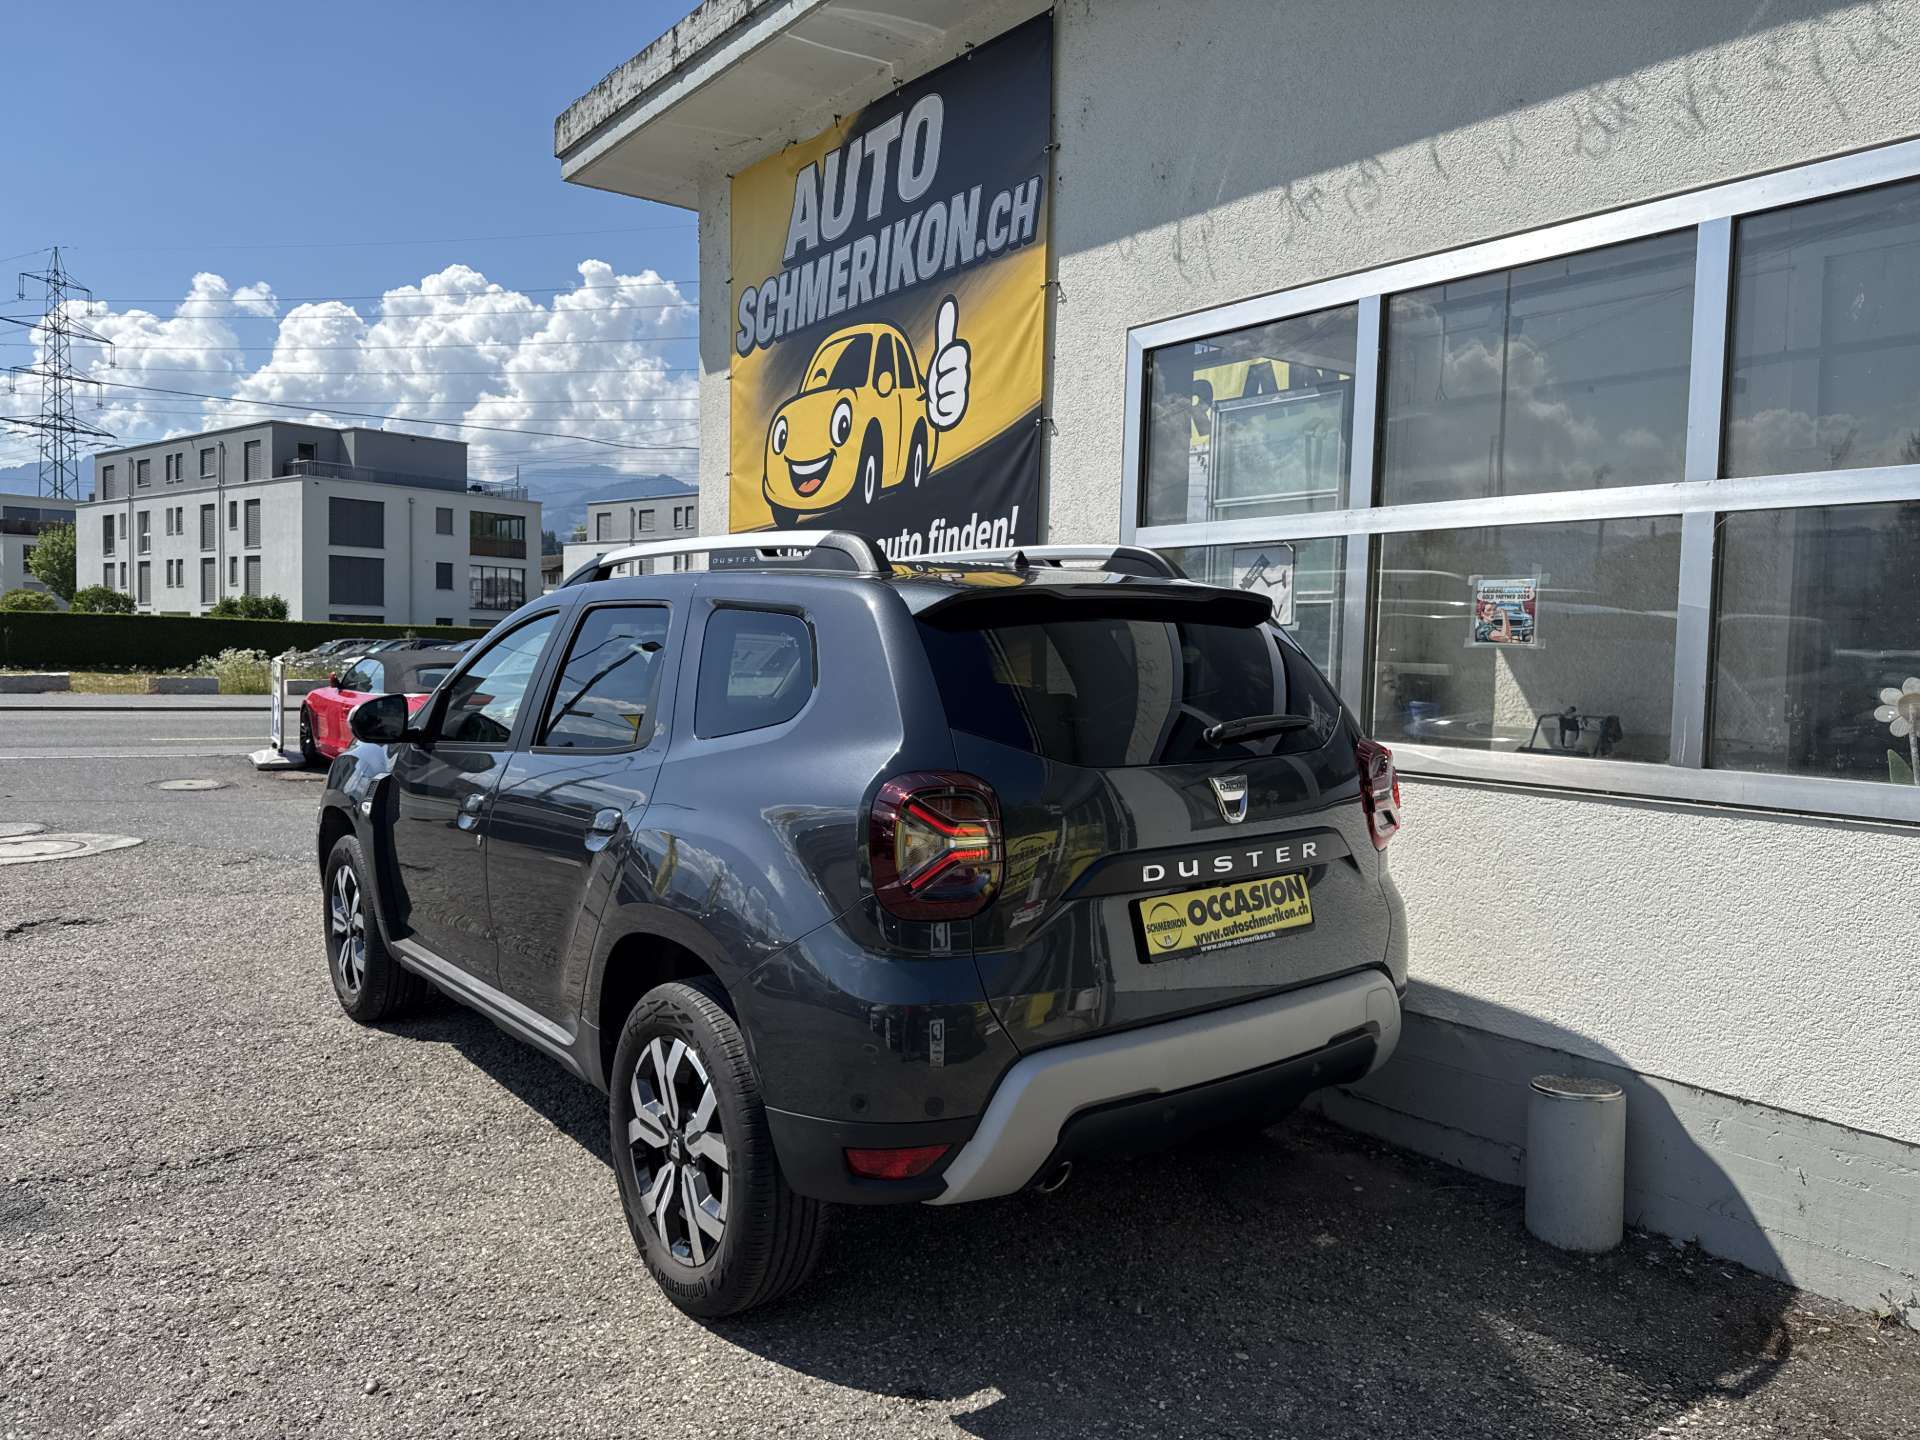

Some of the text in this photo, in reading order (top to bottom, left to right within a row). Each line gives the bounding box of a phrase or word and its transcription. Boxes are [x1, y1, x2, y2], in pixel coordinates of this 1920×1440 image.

[782, 93, 945, 264] AUTO
[736, 175, 1041, 357] SCHMERIKON.CH
[928, 505, 1019, 554] finden!
[712, 556, 756, 565] DUSTER
[1142, 842, 1317, 882] DUSTER
[1187, 874, 1306, 926] OCCASION
[1194, 901, 1309, 945] www.autoschmerikon.ch
[1146, 918, 1187, 934] SCHMERIKON
